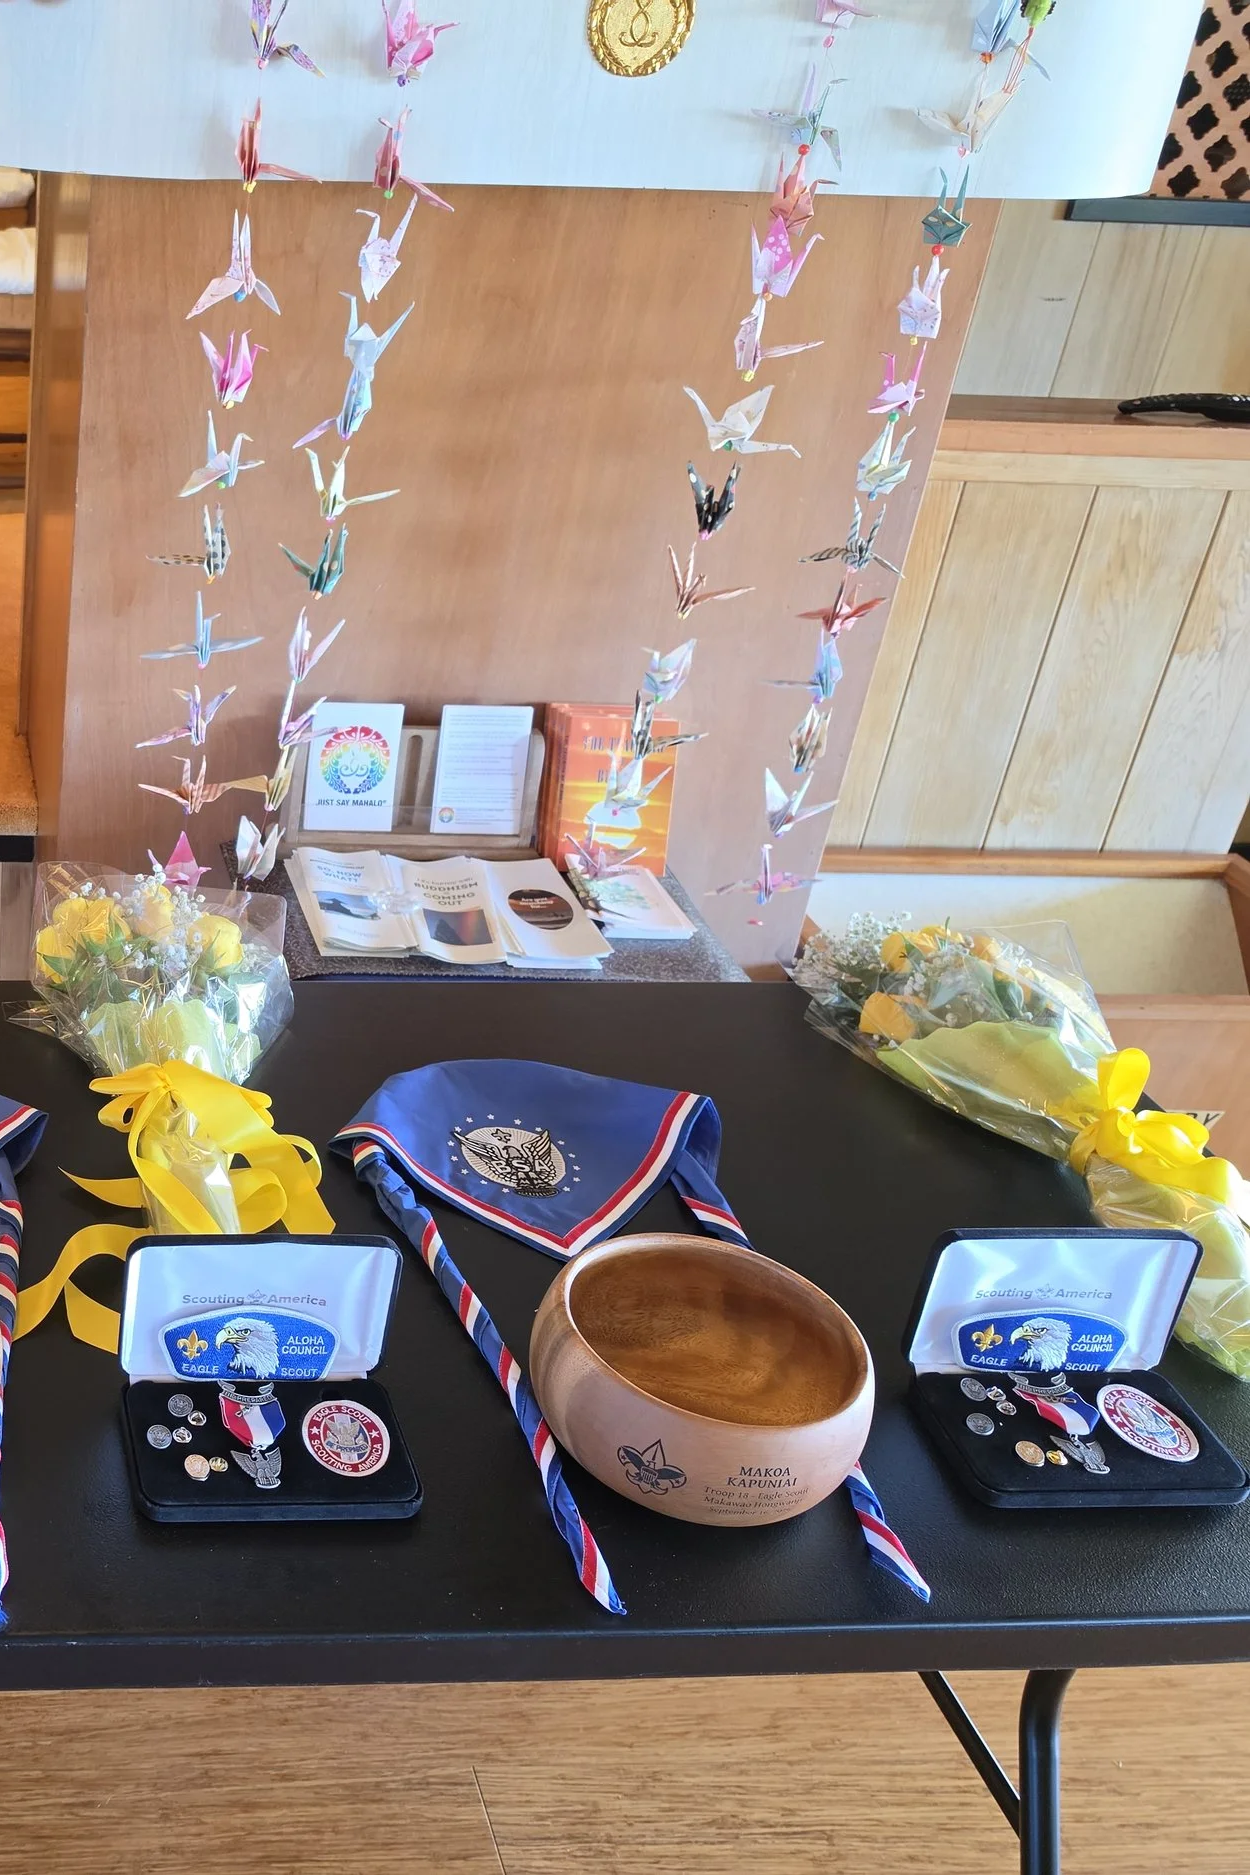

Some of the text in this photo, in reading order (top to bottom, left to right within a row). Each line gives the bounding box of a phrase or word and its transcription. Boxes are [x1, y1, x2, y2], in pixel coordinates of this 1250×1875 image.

[414, 882, 478, 891] BUDDHISM
[493, 1160, 551, 1174] BSA
[975, 1287, 1112, 1299] Scouting America
[182, 1294, 327, 1307] Scouting America
[287, 1335, 325, 1345] ALOHA
[1078, 1334, 1112, 1344] ALOHA
[282, 1346, 328, 1355] COUNCIL
[1071, 1343, 1114, 1353] COUNCIL
[970, 1354, 1100, 1372] EAGLE SCOUT
[182, 1363, 318, 1377] EAGLE SCOUT
[1122, 1391, 1156, 1408] SCOUT
[313, 1406, 372, 1424] EAGLE SCOUT
[1121, 1427, 1178, 1457] SCOUTING
[311, 1439, 382, 1472] SCOUTING AMERICA
[739, 1466, 791, 1477] MAKOA
[727, 1477, 797, 1488] KAPUNIAI
[704, 1486, 735, 1498] Troop
[758, 1492, 782, 1501] Eagle
[785, 1487, 809, 1497] Scout
[704, 1496, 751, 1508] Makawao
